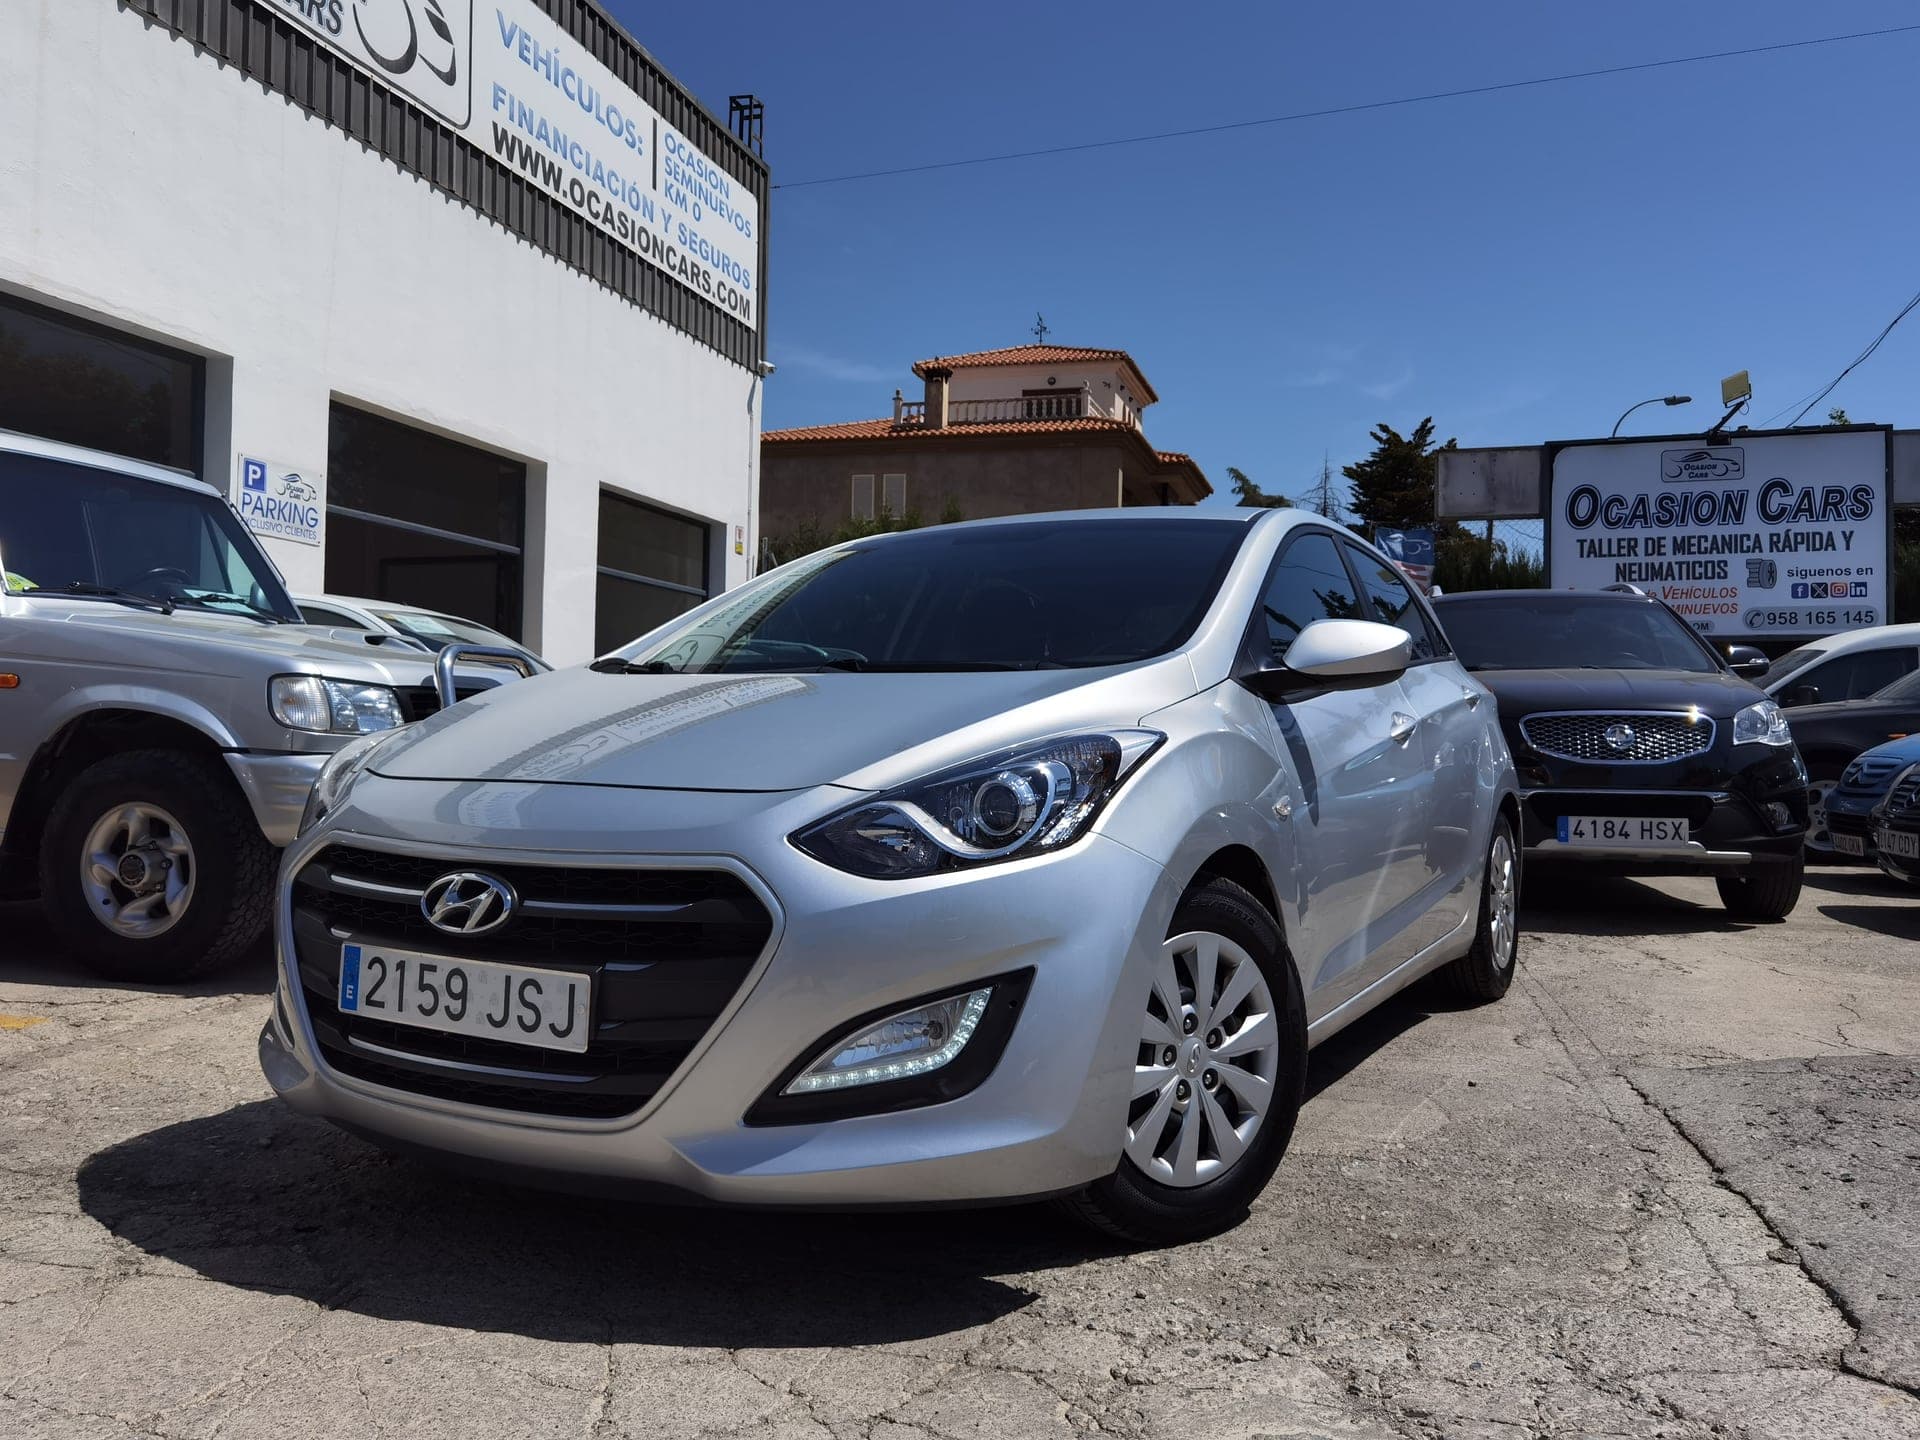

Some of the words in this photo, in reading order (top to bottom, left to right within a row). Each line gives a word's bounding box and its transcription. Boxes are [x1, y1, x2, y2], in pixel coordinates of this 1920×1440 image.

[496, 8, 643, 156] VEHÍCULOS:
[664, 132, 730, 200] OCASION
[492, 81, 655, 224] FINANCIACIÓN
[661, 207, 672, 234] Y
[678, 222, 750, 291] SEGUROS
[664, 178, 688, 214] KM
[664, 155, 752, 239] SEMINUEVOS
[492, 120, 750, 321] WWW.OCASIONCARS.COM
[248, 464, 261, 486] P
[241, 492, 319, 528] PARKING
[1566, 484, 1749, 530] OCASION
[1757, 478, 1874, 525] CARS
[247, 517, 283, 533] XCLUSIVO
[284, 525, 317, 540] CLIENTES
[1576, 537, 1638, 558] TALLER
[1644, 536, 1666, 556] DE
[1672, 532, 1763, 555] MECANICA
[1769, 529, 1836, 553] RÁPIDA
[1841, 530, 1854, 551] Y
[1615, 560, 1728, 582] NEUMATICOS
[1787, 566, 1852, 579] siguenos
[1856, 567, 1873, 576] en
[1662, 586, 1737, 599] VEHÍCULOS
[1671, 603, 1738, 615] MINUEVOS
[1767, 612, 1798, 625] 958
[1805, 610, 1836, 624] 165
[1843, 610, 1874, 624] 145
[1573, 819, 1630, 839] 4184
[1640, 820, 1683, 840] HSX
[345, 984, 354, 1000] E
[365, 956, 469, 1022] 2159
[486, 975, 576, 1039] JSJ
